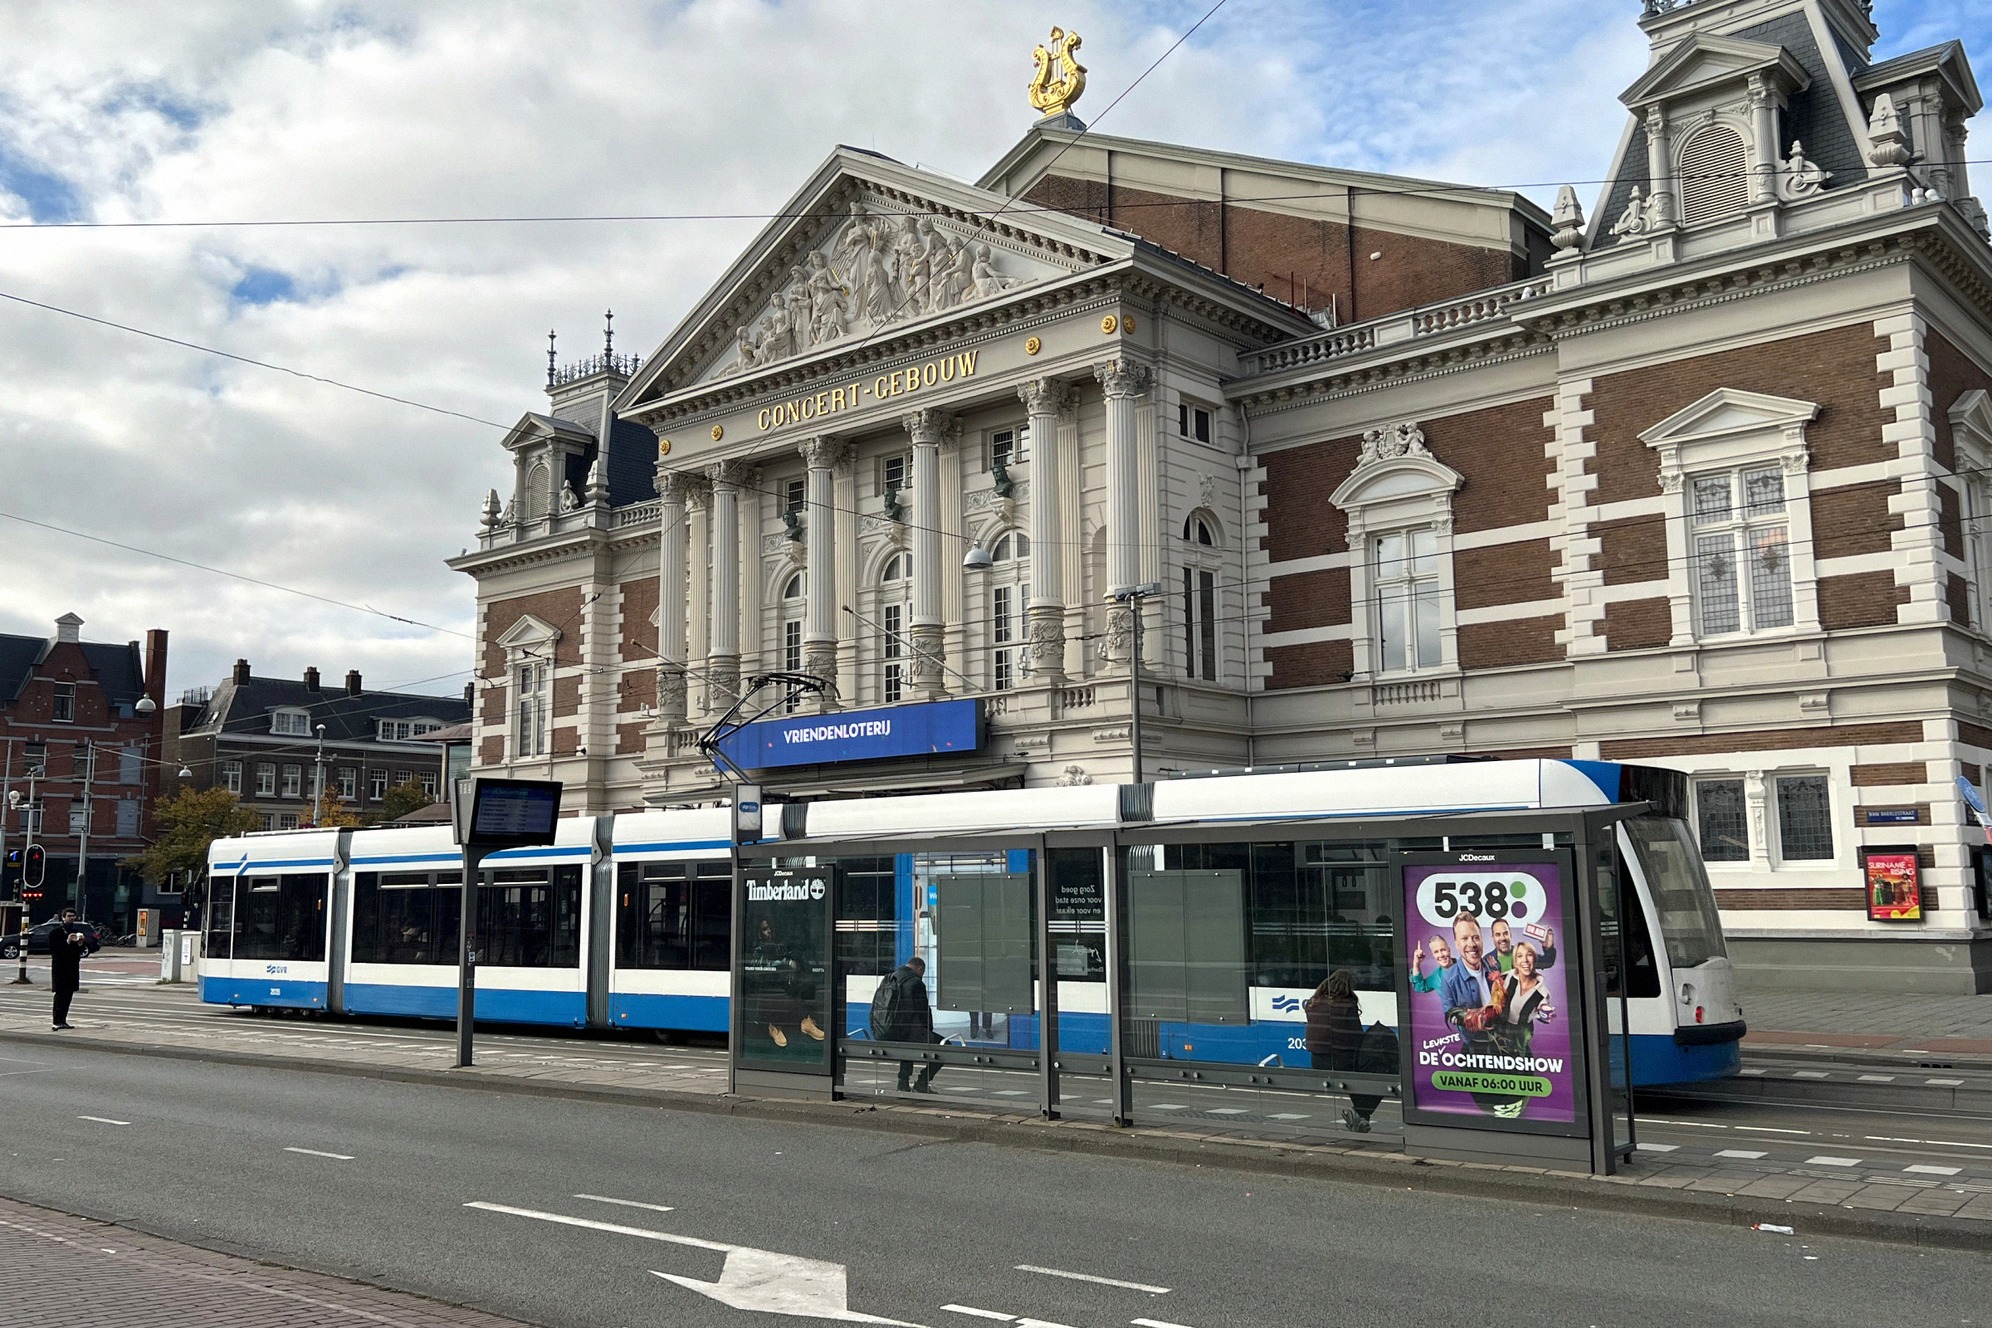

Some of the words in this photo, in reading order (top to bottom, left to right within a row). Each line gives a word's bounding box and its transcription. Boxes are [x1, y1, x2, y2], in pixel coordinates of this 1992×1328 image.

[757, 349, 979, 431] CONCERT-GEBOUW
[783, 720, 891, 744] VRIENDENLOTERIJ
[1458, 853, 1496, 862] JCDecaux
[1867, 861, 1906, 869] SURINAME
[1890, 867, 1915, 876] RISING
[746, 878, 810, 901] Timberland
[1434, 881, 1509, 919] 538
[1422, 1033, 1461, 1050] LEUKSTE
[1419, 1051, 1439, 1066] DE
[1441, 1053, 1564, 1073] OCHTENDSHOW
[1439, 1075, 1479, 1088] VANAF
[1481, 1078, 1517, 1091] 06:00
[1519, 1081, 1544, 1093] UUR
